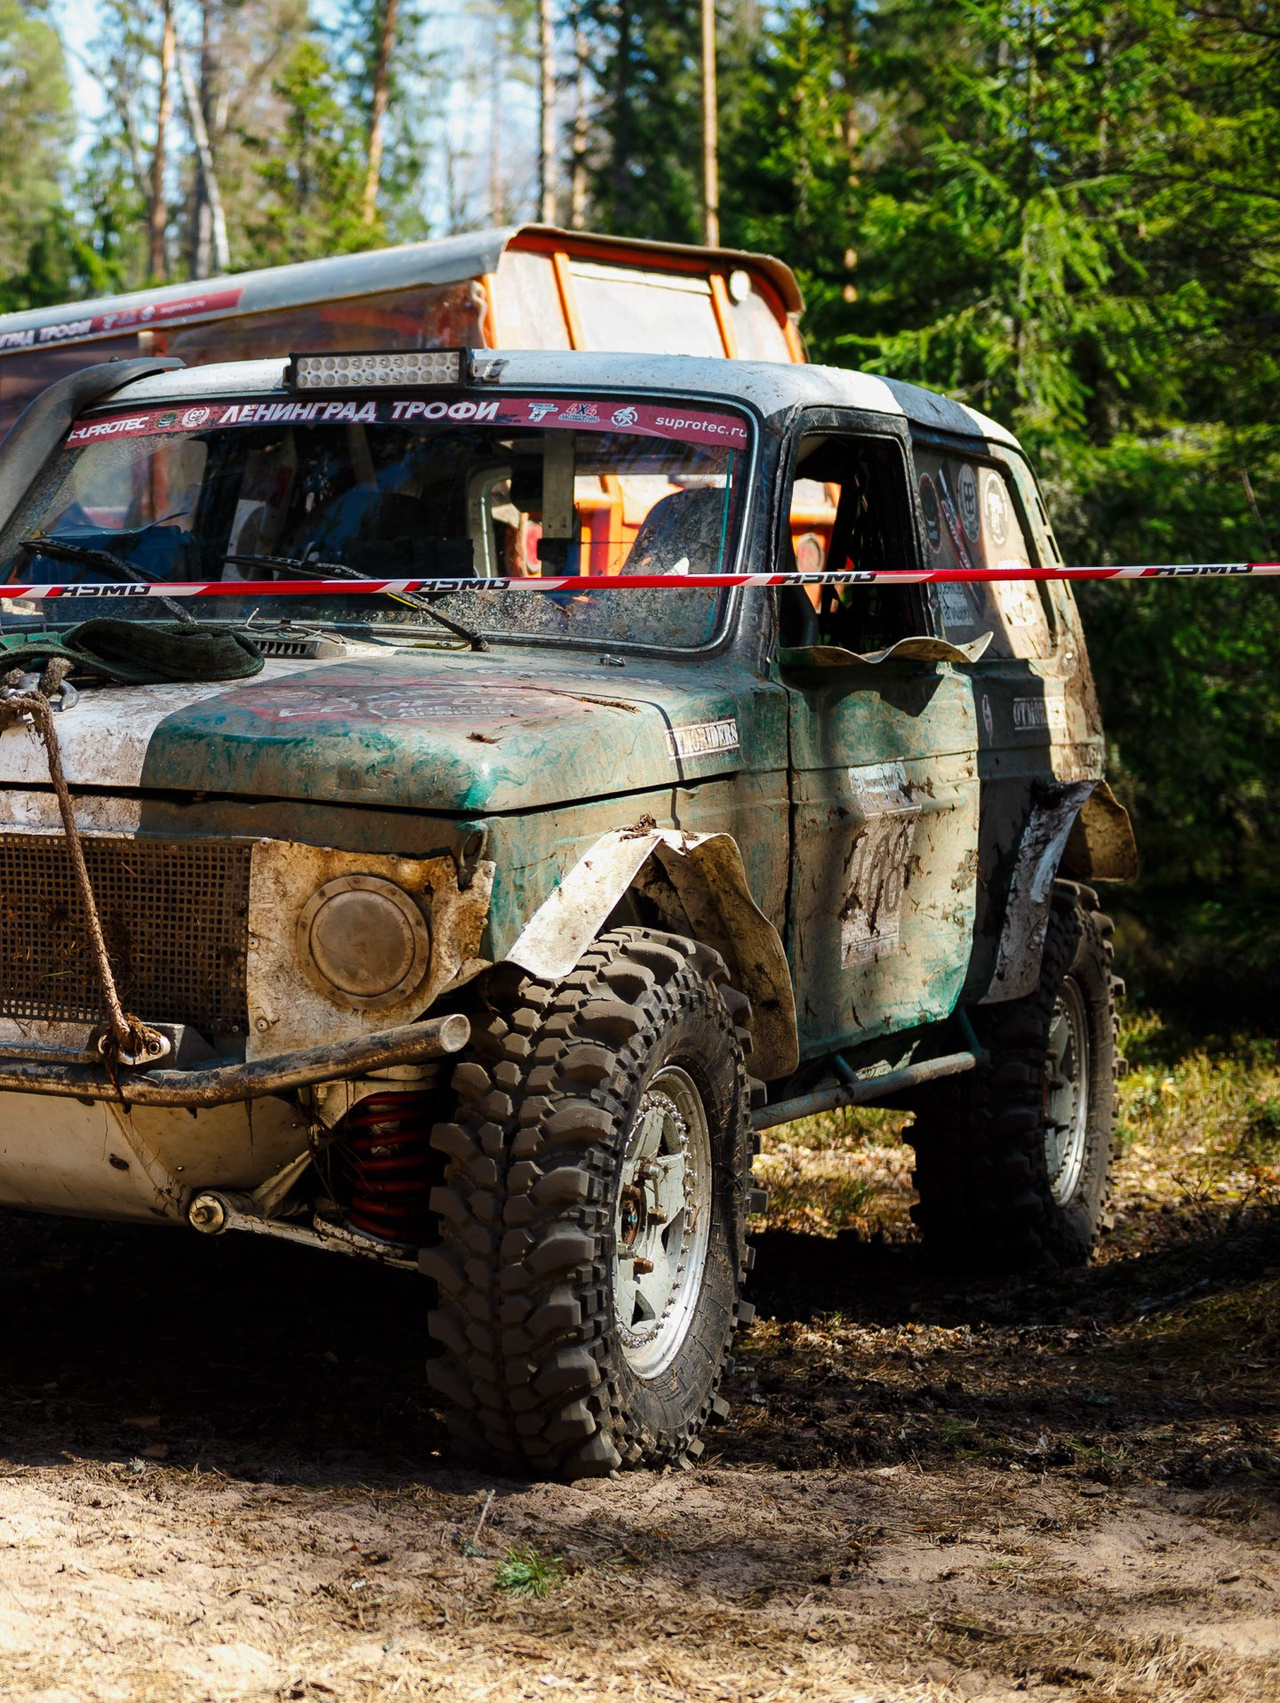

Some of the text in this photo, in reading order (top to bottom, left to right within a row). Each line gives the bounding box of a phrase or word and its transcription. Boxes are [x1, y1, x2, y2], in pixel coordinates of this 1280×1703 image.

[219, 401, 500, 422] ЛЕНИНГРАД ТРОФИ
[655, 416, 748, 438] suprotec.ru
